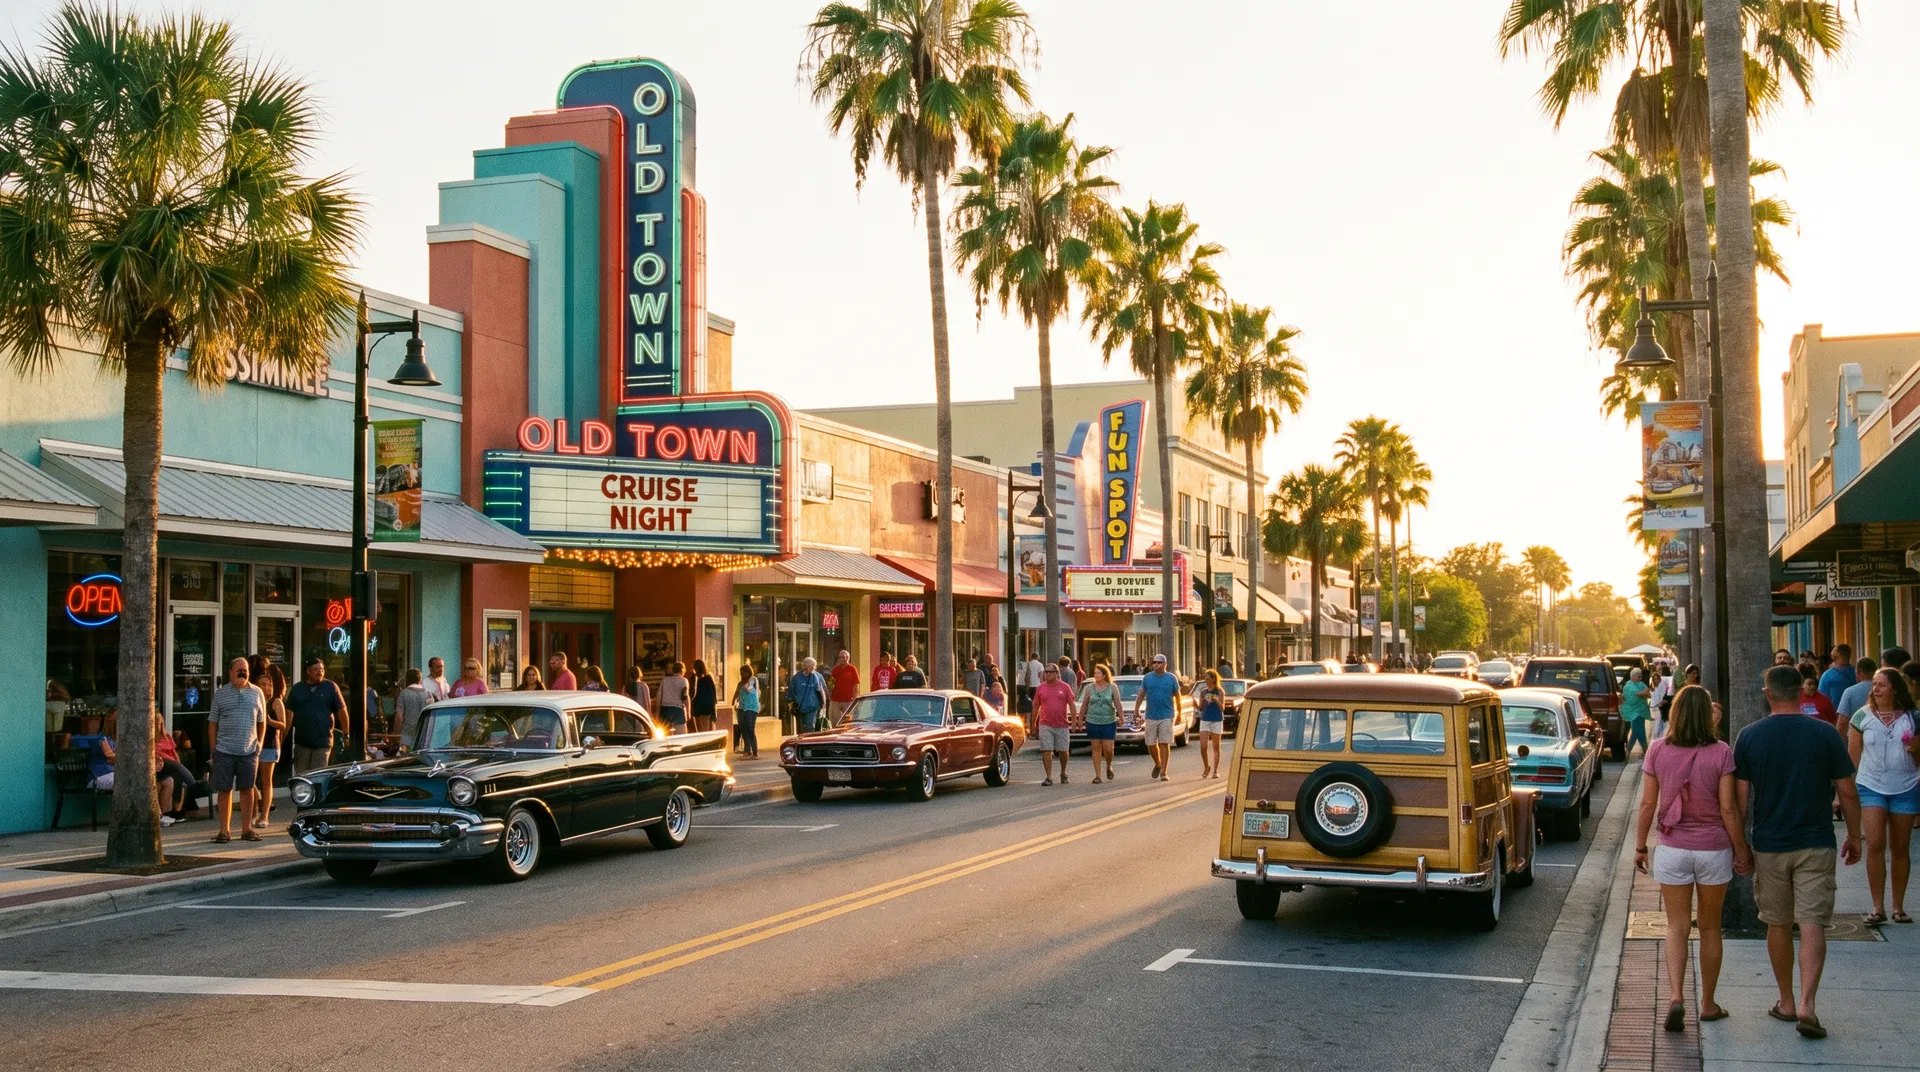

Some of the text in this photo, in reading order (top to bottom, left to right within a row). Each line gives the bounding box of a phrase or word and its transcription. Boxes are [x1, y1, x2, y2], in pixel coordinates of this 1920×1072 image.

[629, 82, 669, 365] OLD TOWN
[224, 343, 329, 397] SSIMMEE
[516, 416, 757, 463] OLD TOWN
[600, 474, 699, 502] CRUISE
[1106, 411, 1128, 559] FUN SPOT
[609, 505, 693, 532] NIGHT
[67, 584, 123, 614] OPEN
[1094, 577, 1112, 585] OLD
